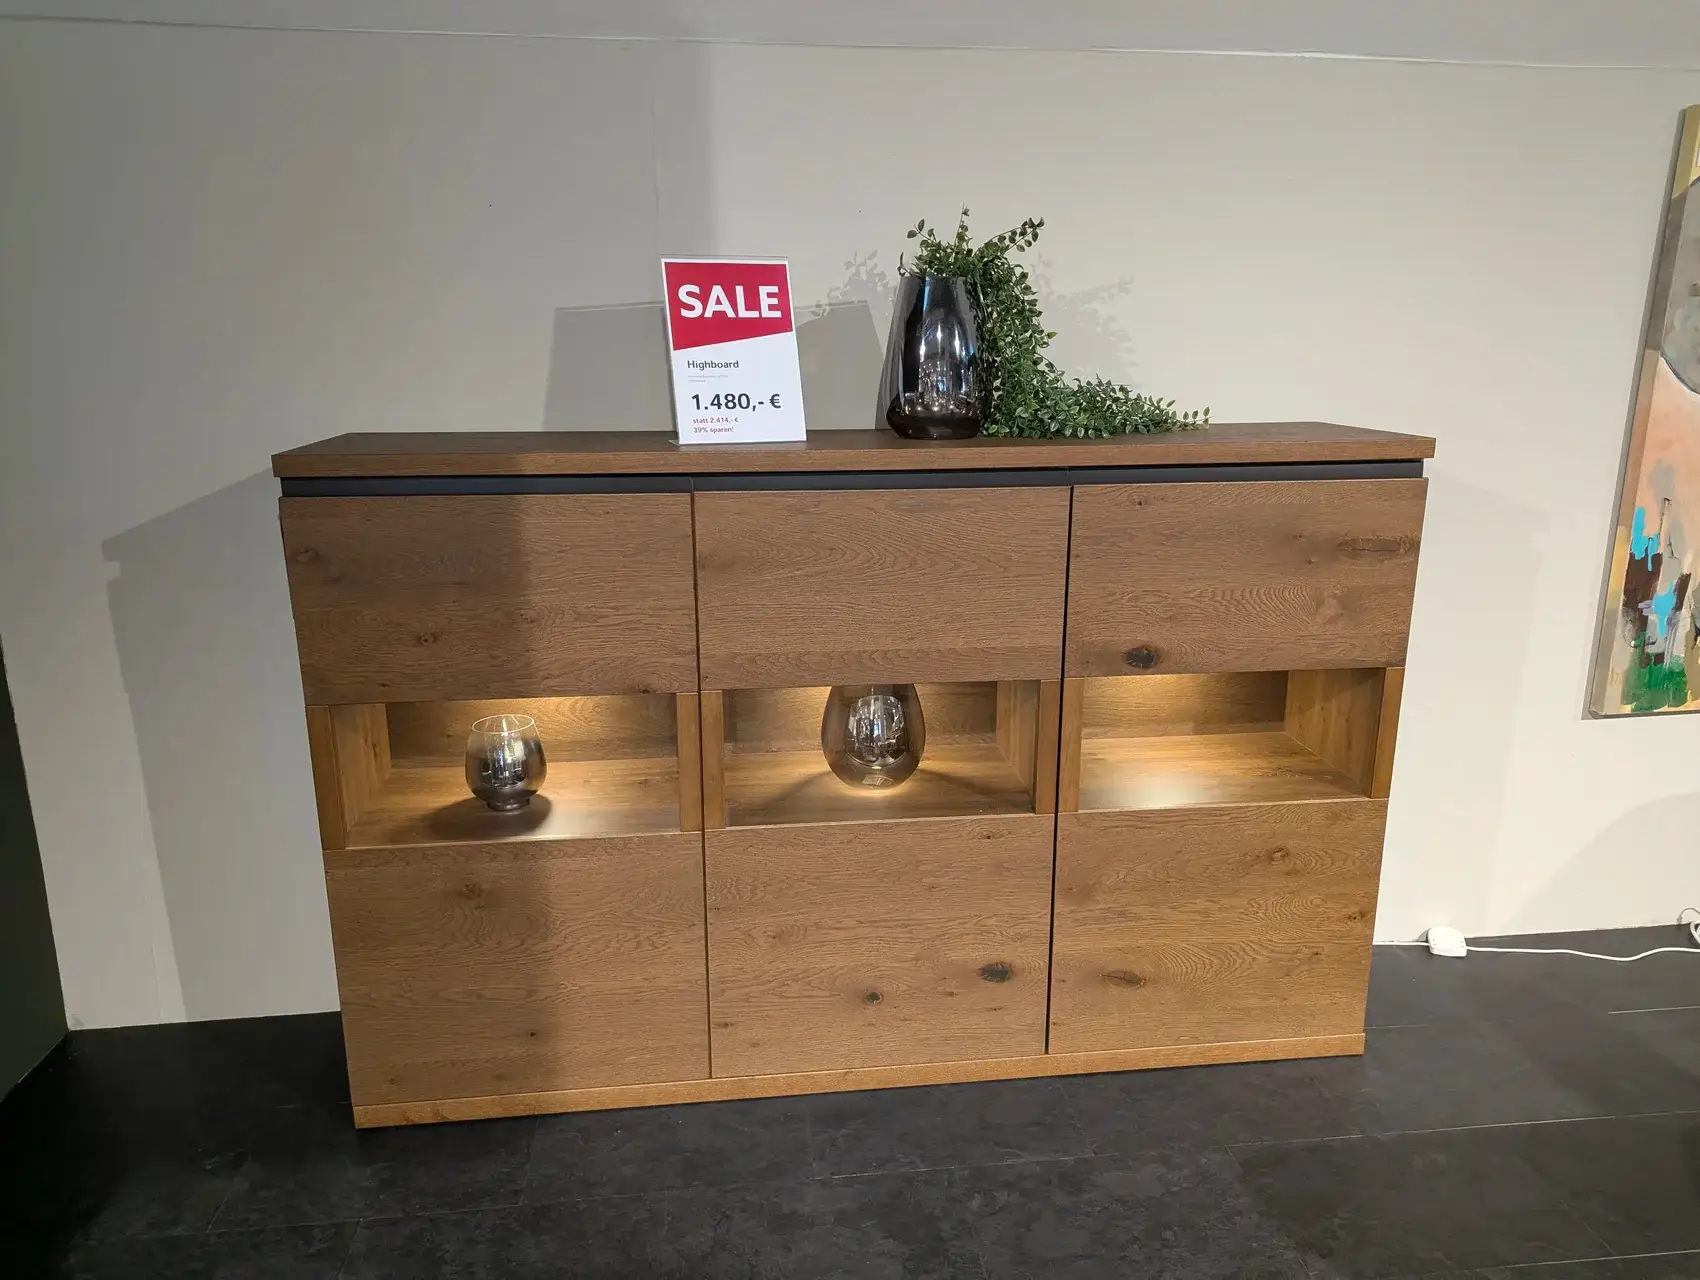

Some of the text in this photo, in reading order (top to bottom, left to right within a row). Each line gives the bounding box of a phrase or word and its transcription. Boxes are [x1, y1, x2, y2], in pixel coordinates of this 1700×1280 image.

[678, 284, 782, 319] SALE
[687, 360, 739, 371] Highboard
[691, 393, 782, 412] 1.480,- €
[710, 426, 734, 434] sparen!
